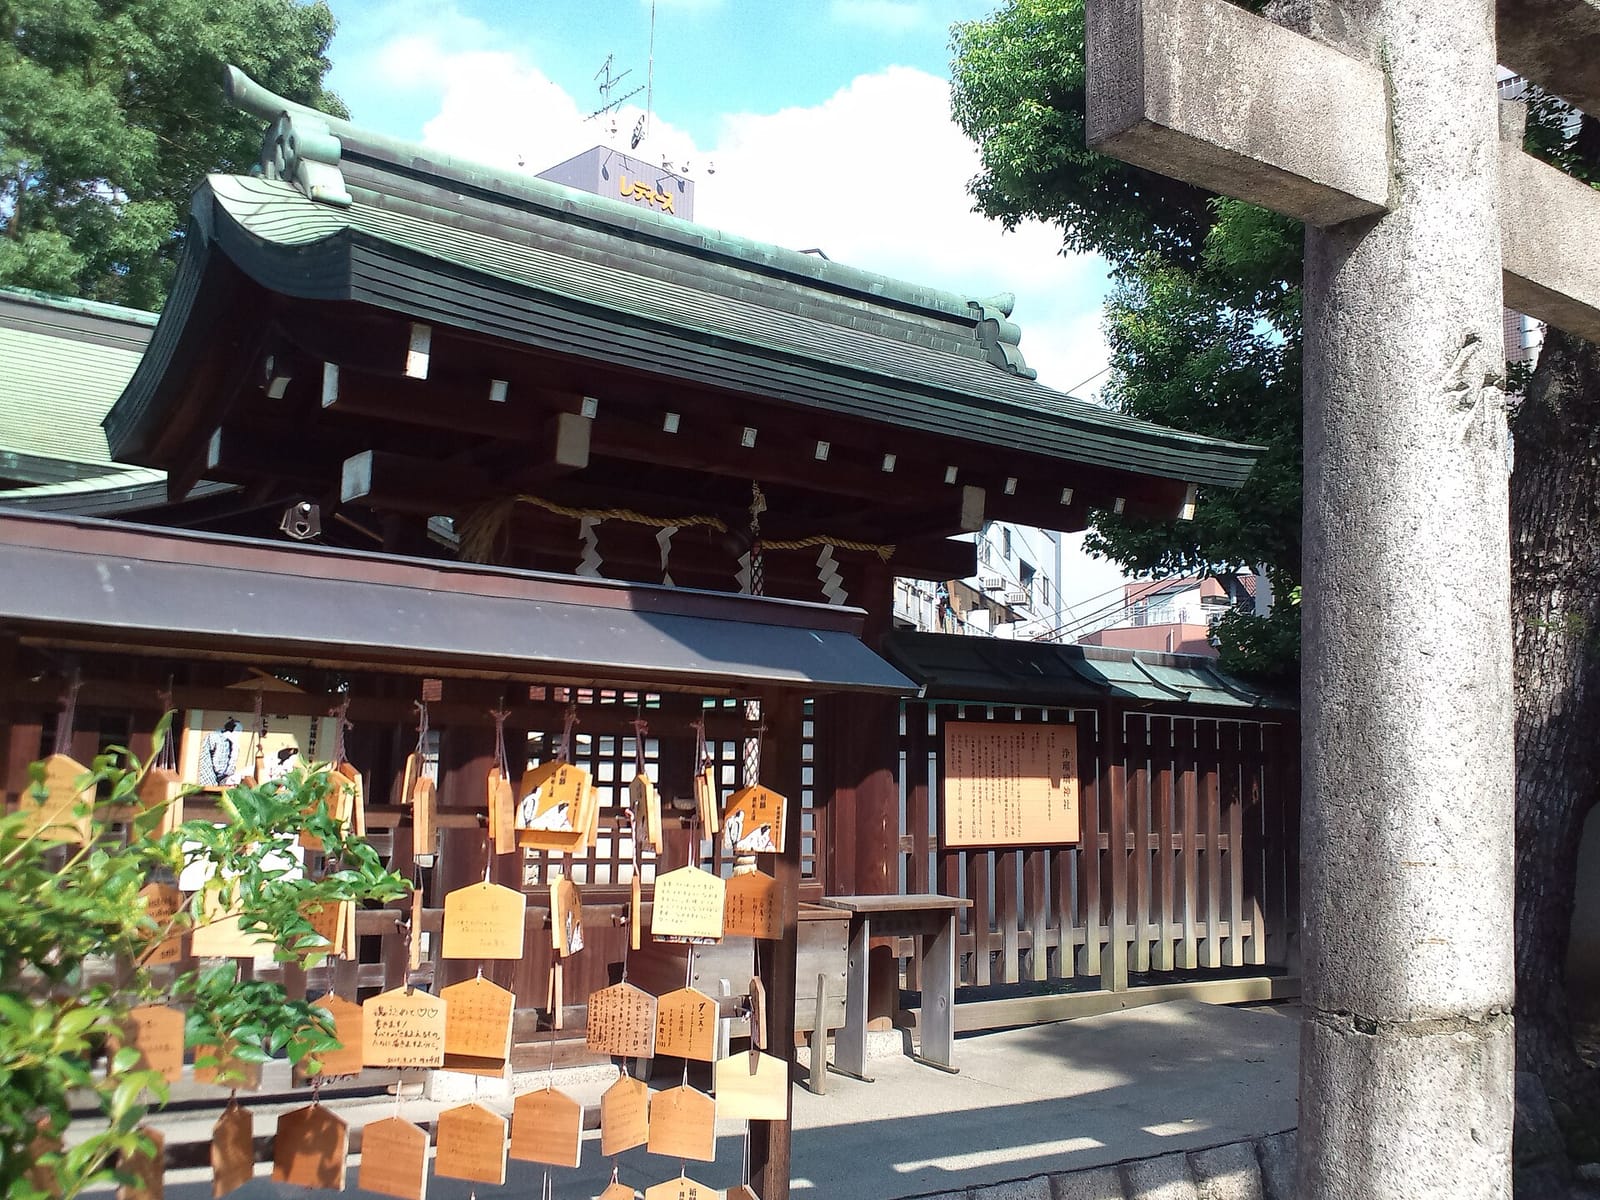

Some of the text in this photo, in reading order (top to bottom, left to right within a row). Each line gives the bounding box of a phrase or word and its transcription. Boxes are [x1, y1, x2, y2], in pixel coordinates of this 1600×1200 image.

[620, 176, 675, 214] レディース
[1062, 747, 1071, 810] 浄瑠璃神社
